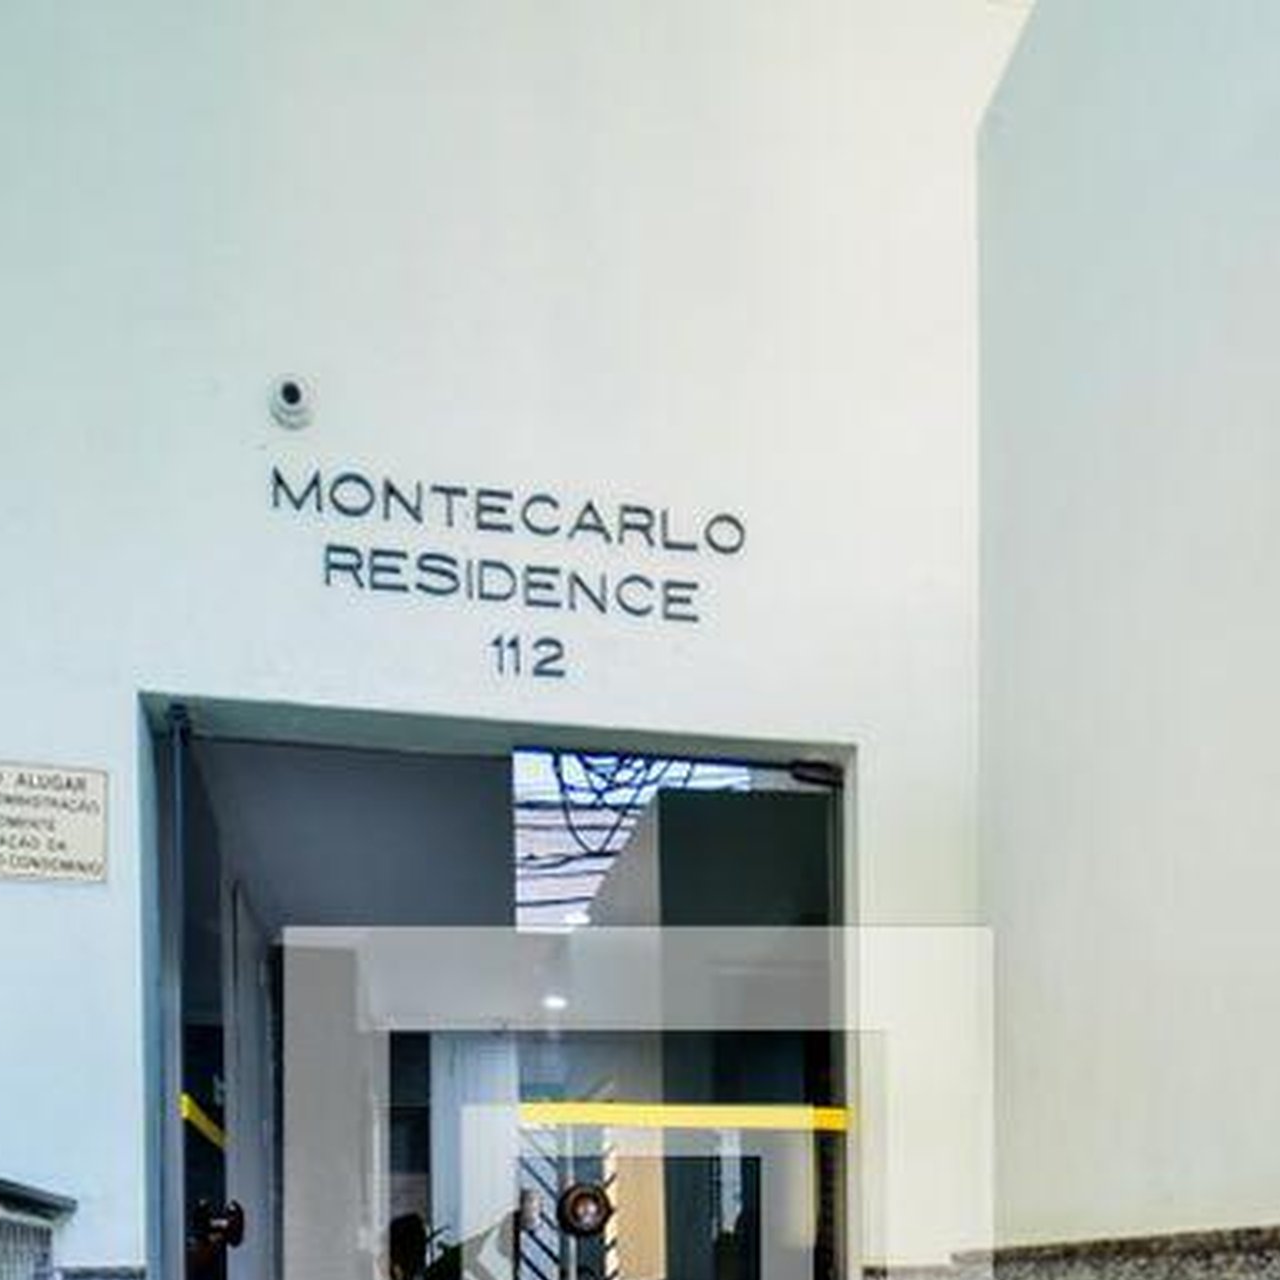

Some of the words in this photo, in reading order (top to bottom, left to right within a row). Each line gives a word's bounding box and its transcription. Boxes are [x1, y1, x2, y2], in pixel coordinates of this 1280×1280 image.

[271, 466, 746, 554] MONTECARLO
[323, 544, 700, 622] RESIDENCE
[492, 634, 566, 677] 112
[16, 772, 87, 792] ALUGAR
